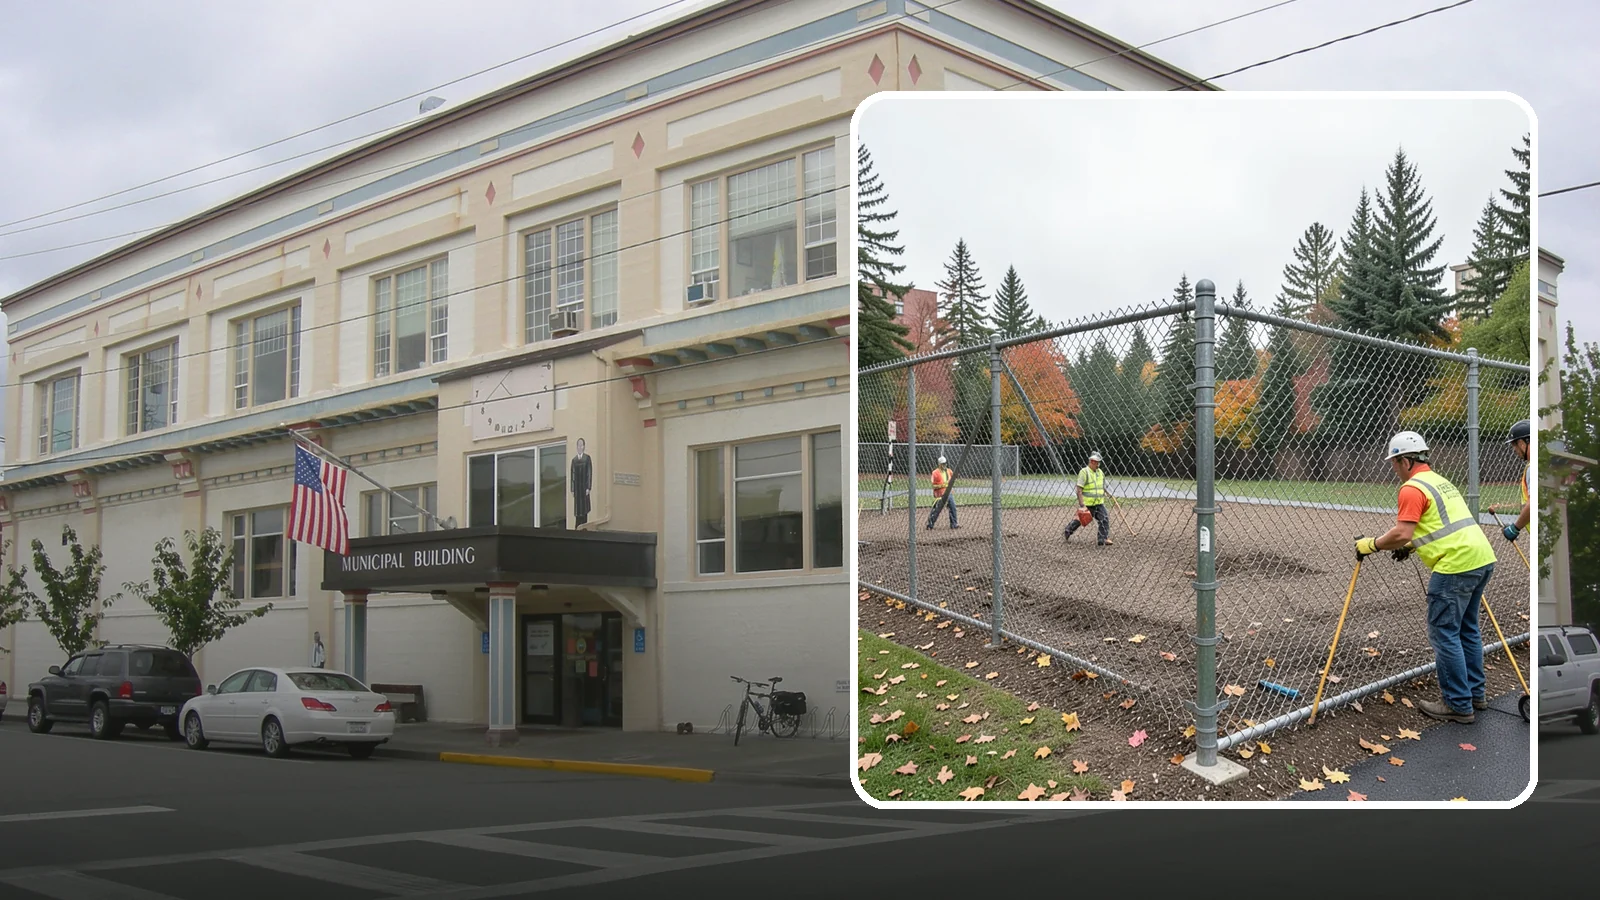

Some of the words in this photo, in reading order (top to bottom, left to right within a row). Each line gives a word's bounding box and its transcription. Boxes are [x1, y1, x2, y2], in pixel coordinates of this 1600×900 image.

[481, 407, 485, 415] 8
[488, 418, 492, 426] 9
[521, 420, 525, 428] 2
[529, 414, 533, 422] 3
[342, 552, 405, 572] MUNICIPAL
[414, 546, 475, 567] BUILDING
